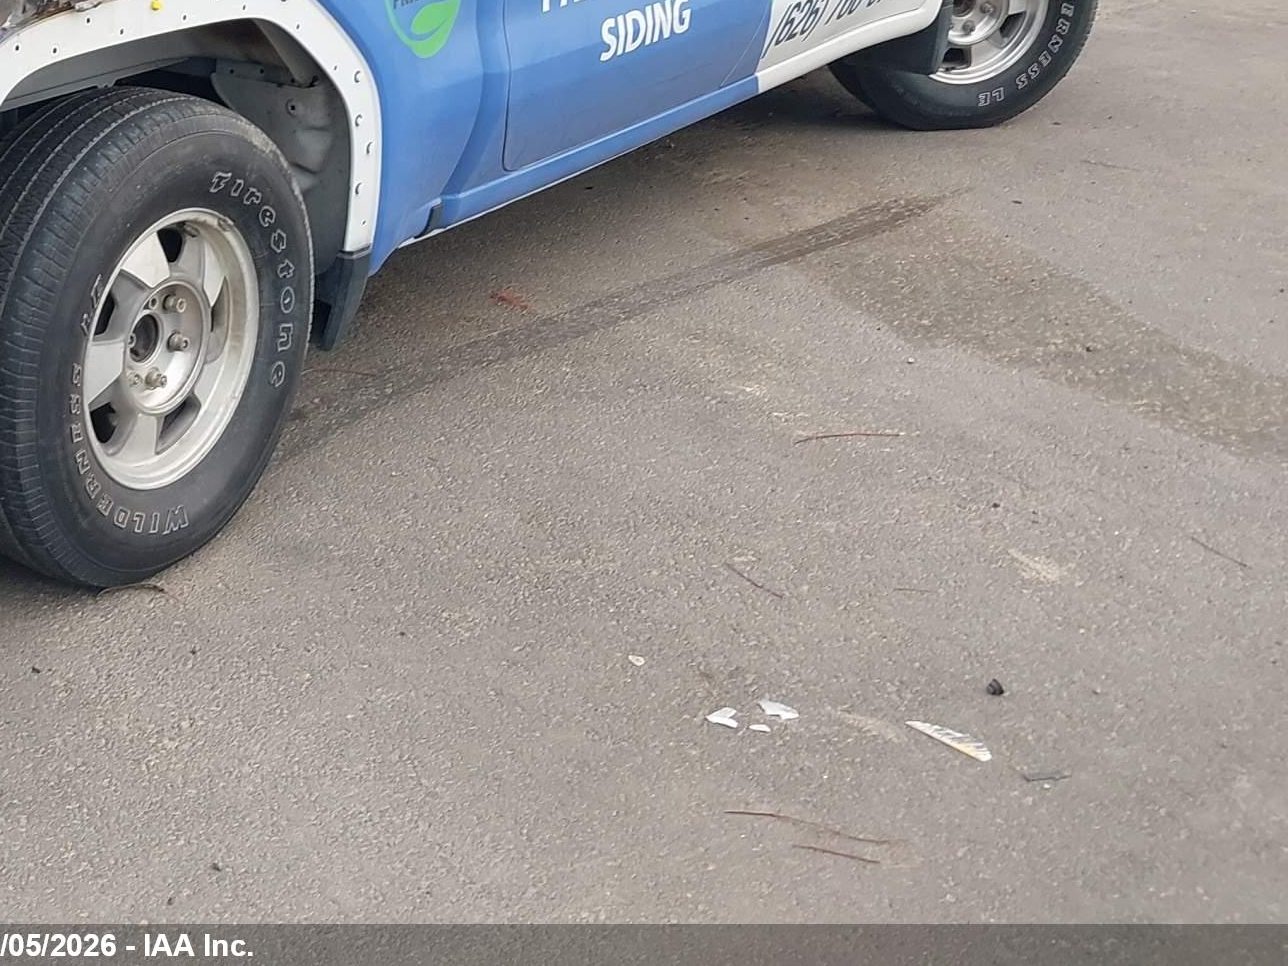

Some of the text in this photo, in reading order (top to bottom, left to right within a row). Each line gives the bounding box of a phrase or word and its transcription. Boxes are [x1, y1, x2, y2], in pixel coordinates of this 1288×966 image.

[978, 86, 1005, 107] LE
[209, 171, 296, 388] Firestone
[69, 362, 189, 535] WILDERNESS
